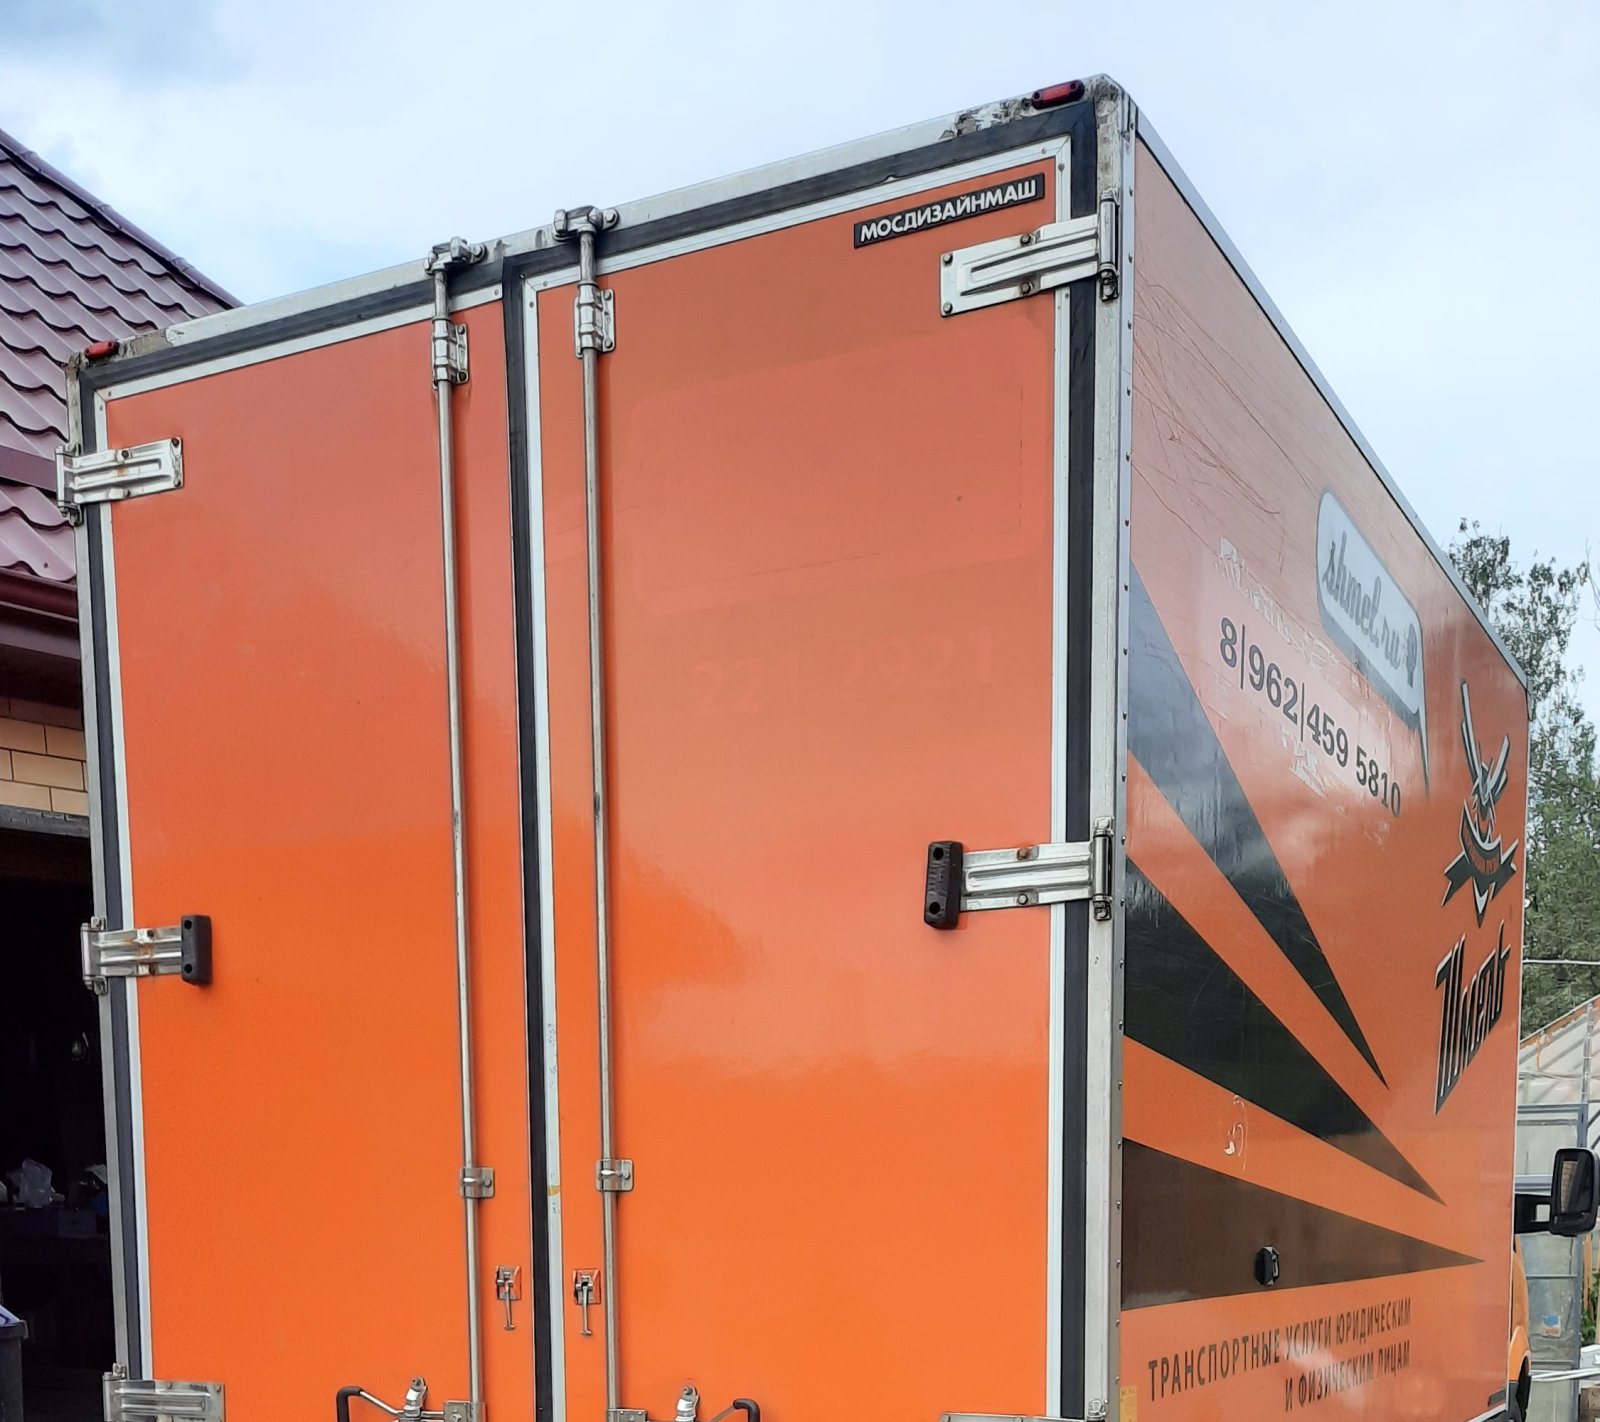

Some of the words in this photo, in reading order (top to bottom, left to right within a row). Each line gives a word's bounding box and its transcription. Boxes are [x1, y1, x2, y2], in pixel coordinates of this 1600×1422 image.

[860, 179, 1036, 242] МОСДИЗАЙНМАШ
[1322, 530, 1401, 669] shmel.ru
[1355, 743, 1402, 818] 5810
[1149, 1328, 1280, 1402] ТРАНСПОРТНЫЕ
[1286, 1316, 1331, 1361] УСЛУГИ
[1336, 1297, 1411, 1346] ЮРИДИЧЕСКИМ
[1285, 1377, 1293, 1412] И
[1298, 1351, 1374, 1409] ФИЗИЧЕСКИМ
[1378, 1340, 1410, 1380] ЛИЦАМ
